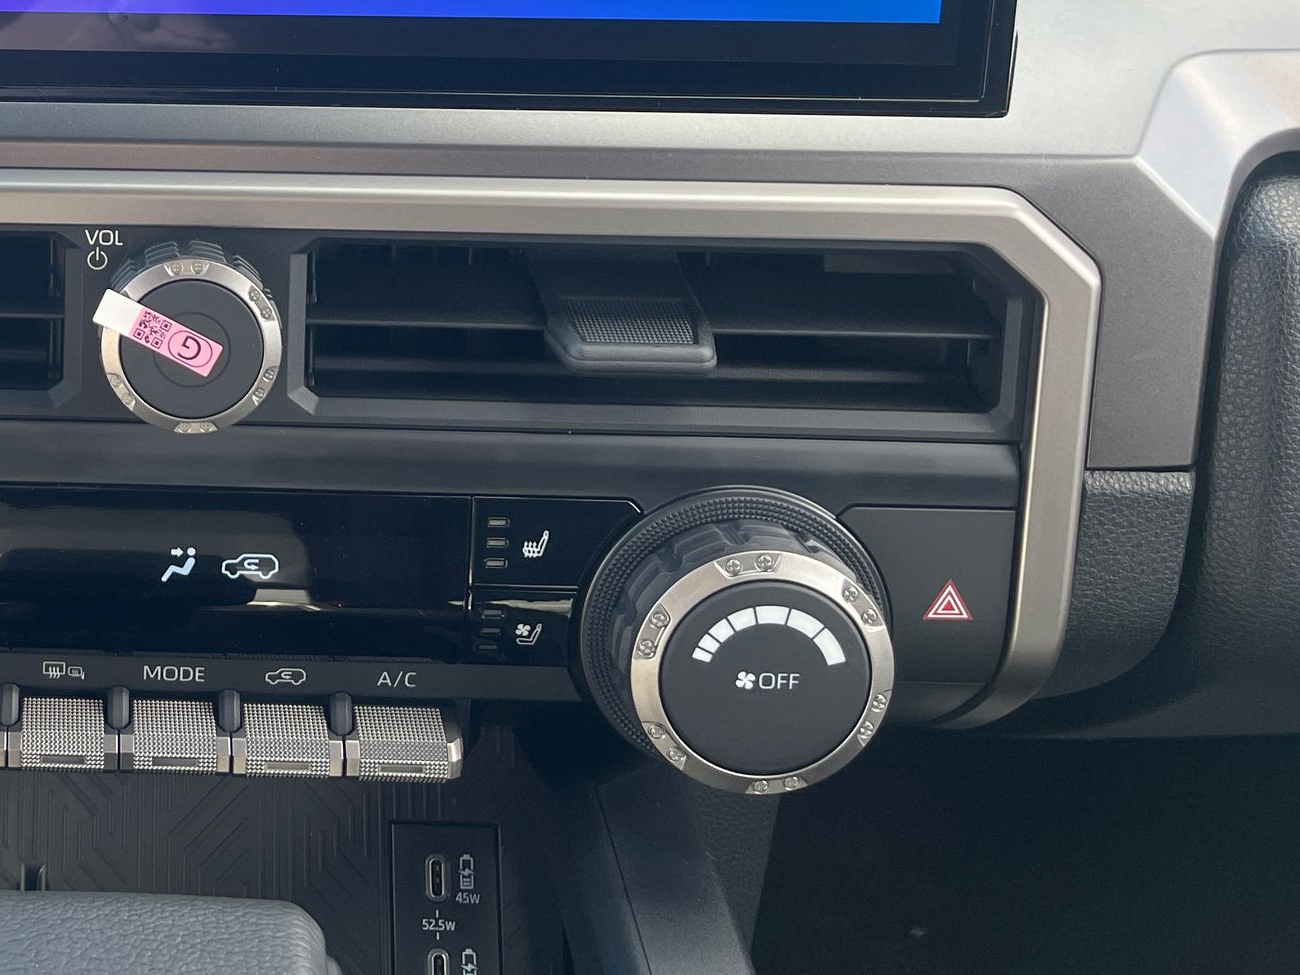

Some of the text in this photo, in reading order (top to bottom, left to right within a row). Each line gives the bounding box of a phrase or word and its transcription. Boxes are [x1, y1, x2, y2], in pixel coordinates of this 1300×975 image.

[85, 229, 123, 246] VOL
[143, 665, 206, 684] MODE
[377, 671, 418, 689] A/C
[758, 672, 800, 690] OFF
[455, 892, 481, 905] 45W
[422, 918, 456, 931] 52.5W
